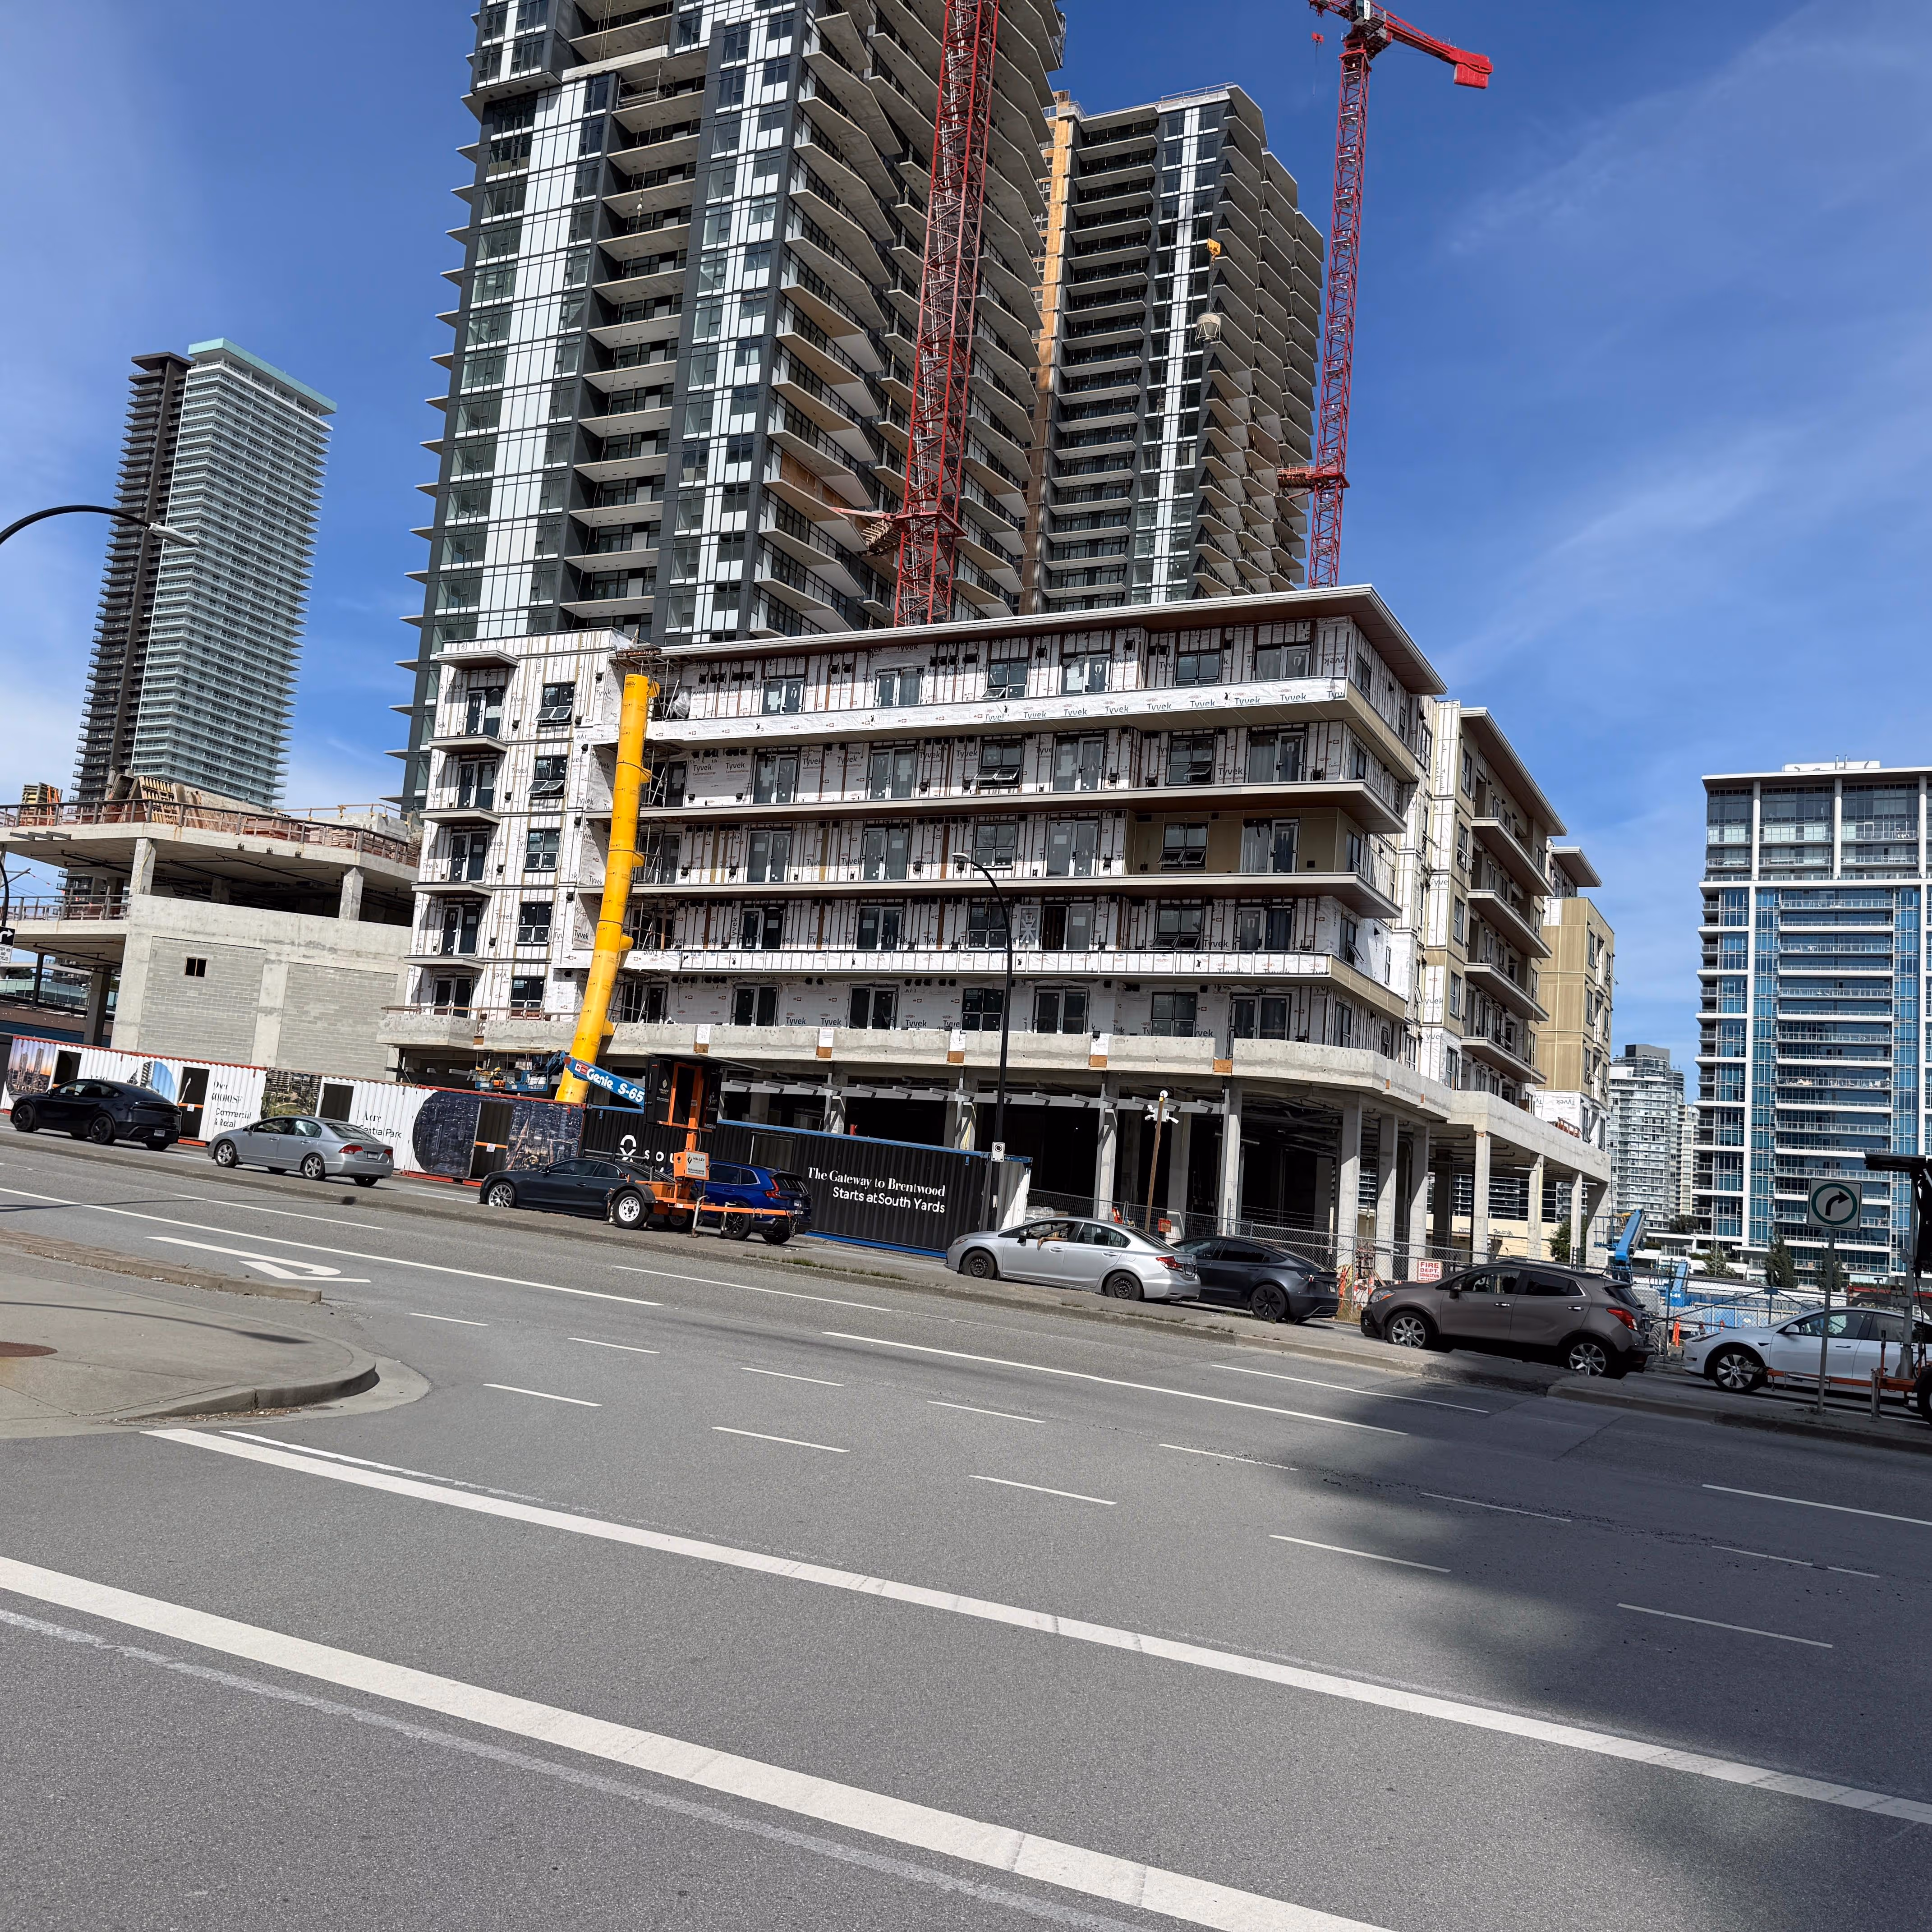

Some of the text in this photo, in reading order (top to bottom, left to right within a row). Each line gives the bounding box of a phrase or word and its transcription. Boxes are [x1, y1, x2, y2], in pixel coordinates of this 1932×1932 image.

[1234, 696, 1260, 705] Tyvek
[1280, 693, 1306, 702] Tyvek
[1147, 702, 1171, 711] Tyvek
[1190, 699, 1215, 708] Tyvek
[1064, 708, 1087, 716] Tyvek
[1105, 705, 1128, 713] Tyvek
[1035, 746, 1053, 755] Tyve
[837, 756, 857, 765] Tyek
[693, 764, 712, 773] Tyvek
[726, 762, 745, 770] Tyvek
[1218, 767, 1242, 777] Tyvek
[574, 929, 589, 940] Tyvek
[809, 936, 829, 944] Tyek
[1203, 939, 1228, 948] Tyvek
[786, 1017, 806, 1026] Tyvek
[821, 1018, 841, 1026] Tyvek
[905, 1019, 927, 1027] Tyvek
[586, 1068, 613, 1090] Genie
[618, 1083, 645, 1103] S-65
[386, 1128, 402, 1138] Park
[808, 1167, 827, 1180] The
[875, 1178, 885, 1188] to
[888, 1178, 946, 1196] Brentwood
[833, 1187, 945, 1213] Starts at South Yards
